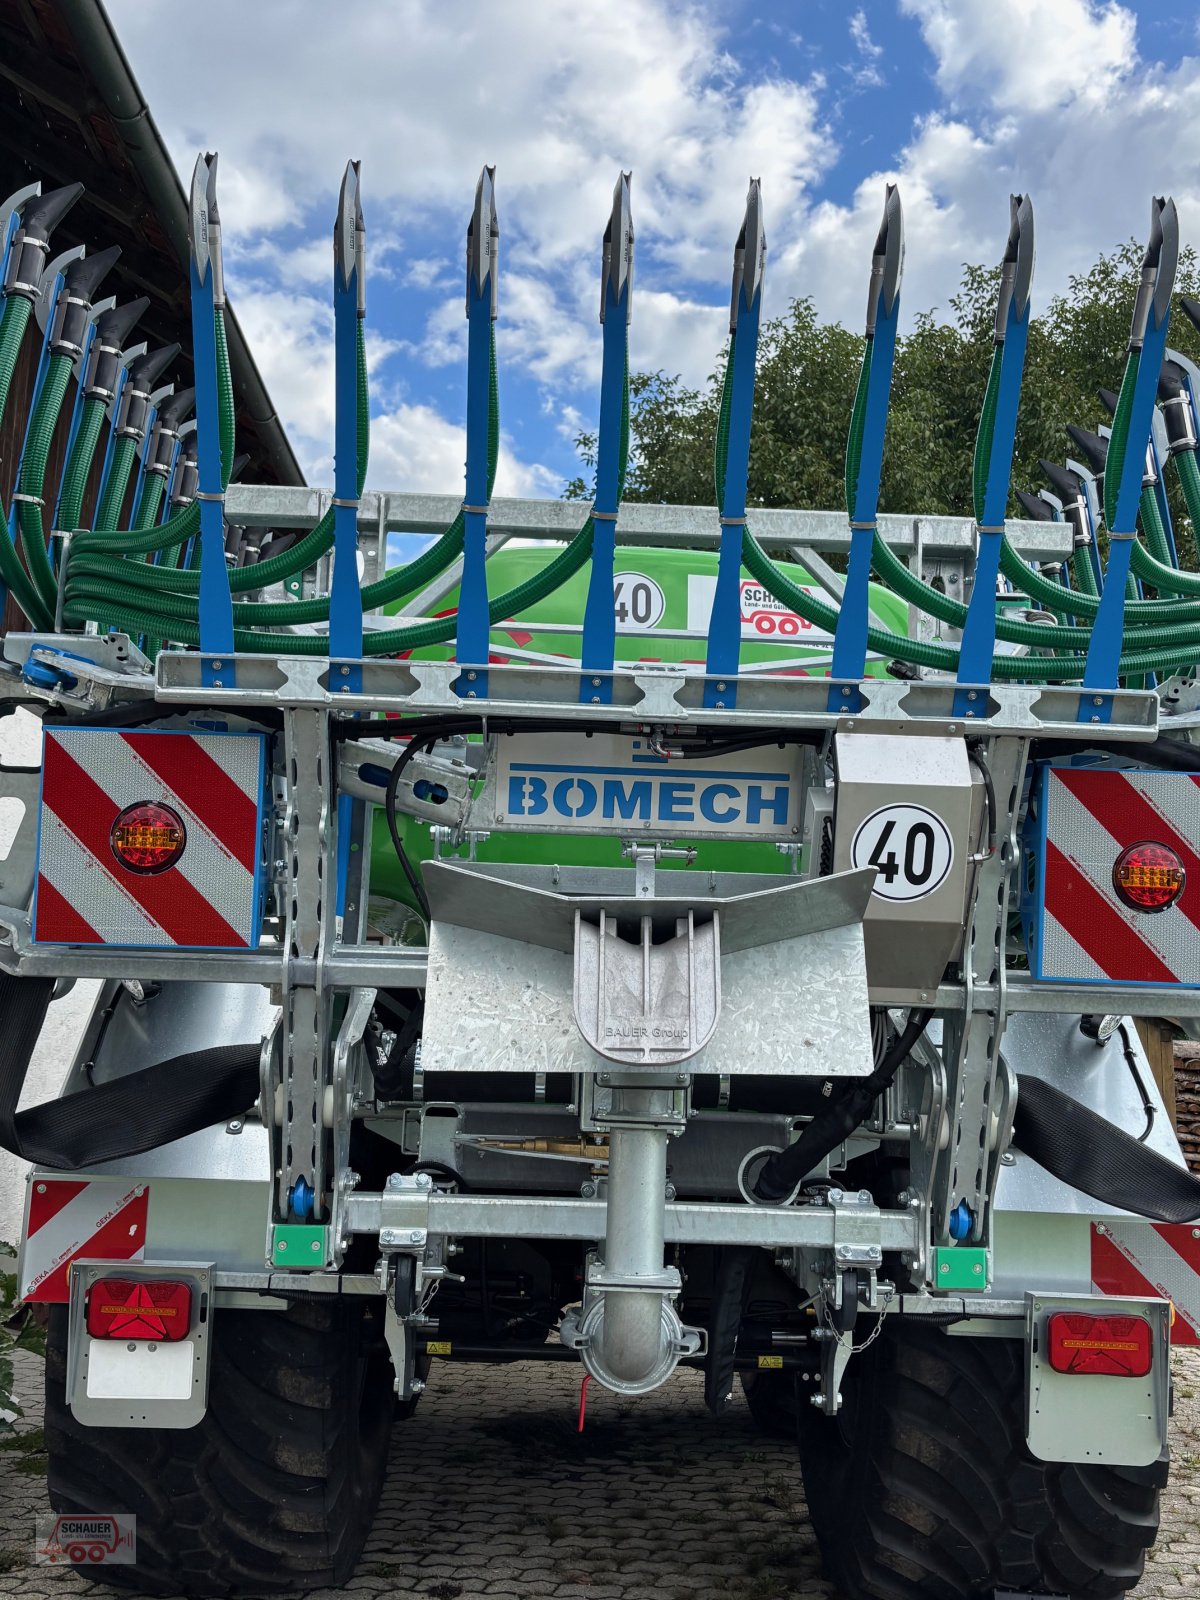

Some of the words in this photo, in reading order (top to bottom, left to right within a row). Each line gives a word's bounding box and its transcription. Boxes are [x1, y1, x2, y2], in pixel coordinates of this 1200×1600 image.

[614, 582, 651, 623] 40
[745, 588, 779, 603] SCH
[508, 776, 790, 825] BOMECH
[868, 820, 935, 886] 40
[605, 1027, 648, 1038] BAUER
[652, 1027, 689, 1040] Group
[95, 1211, 115, 1229] GEKA
